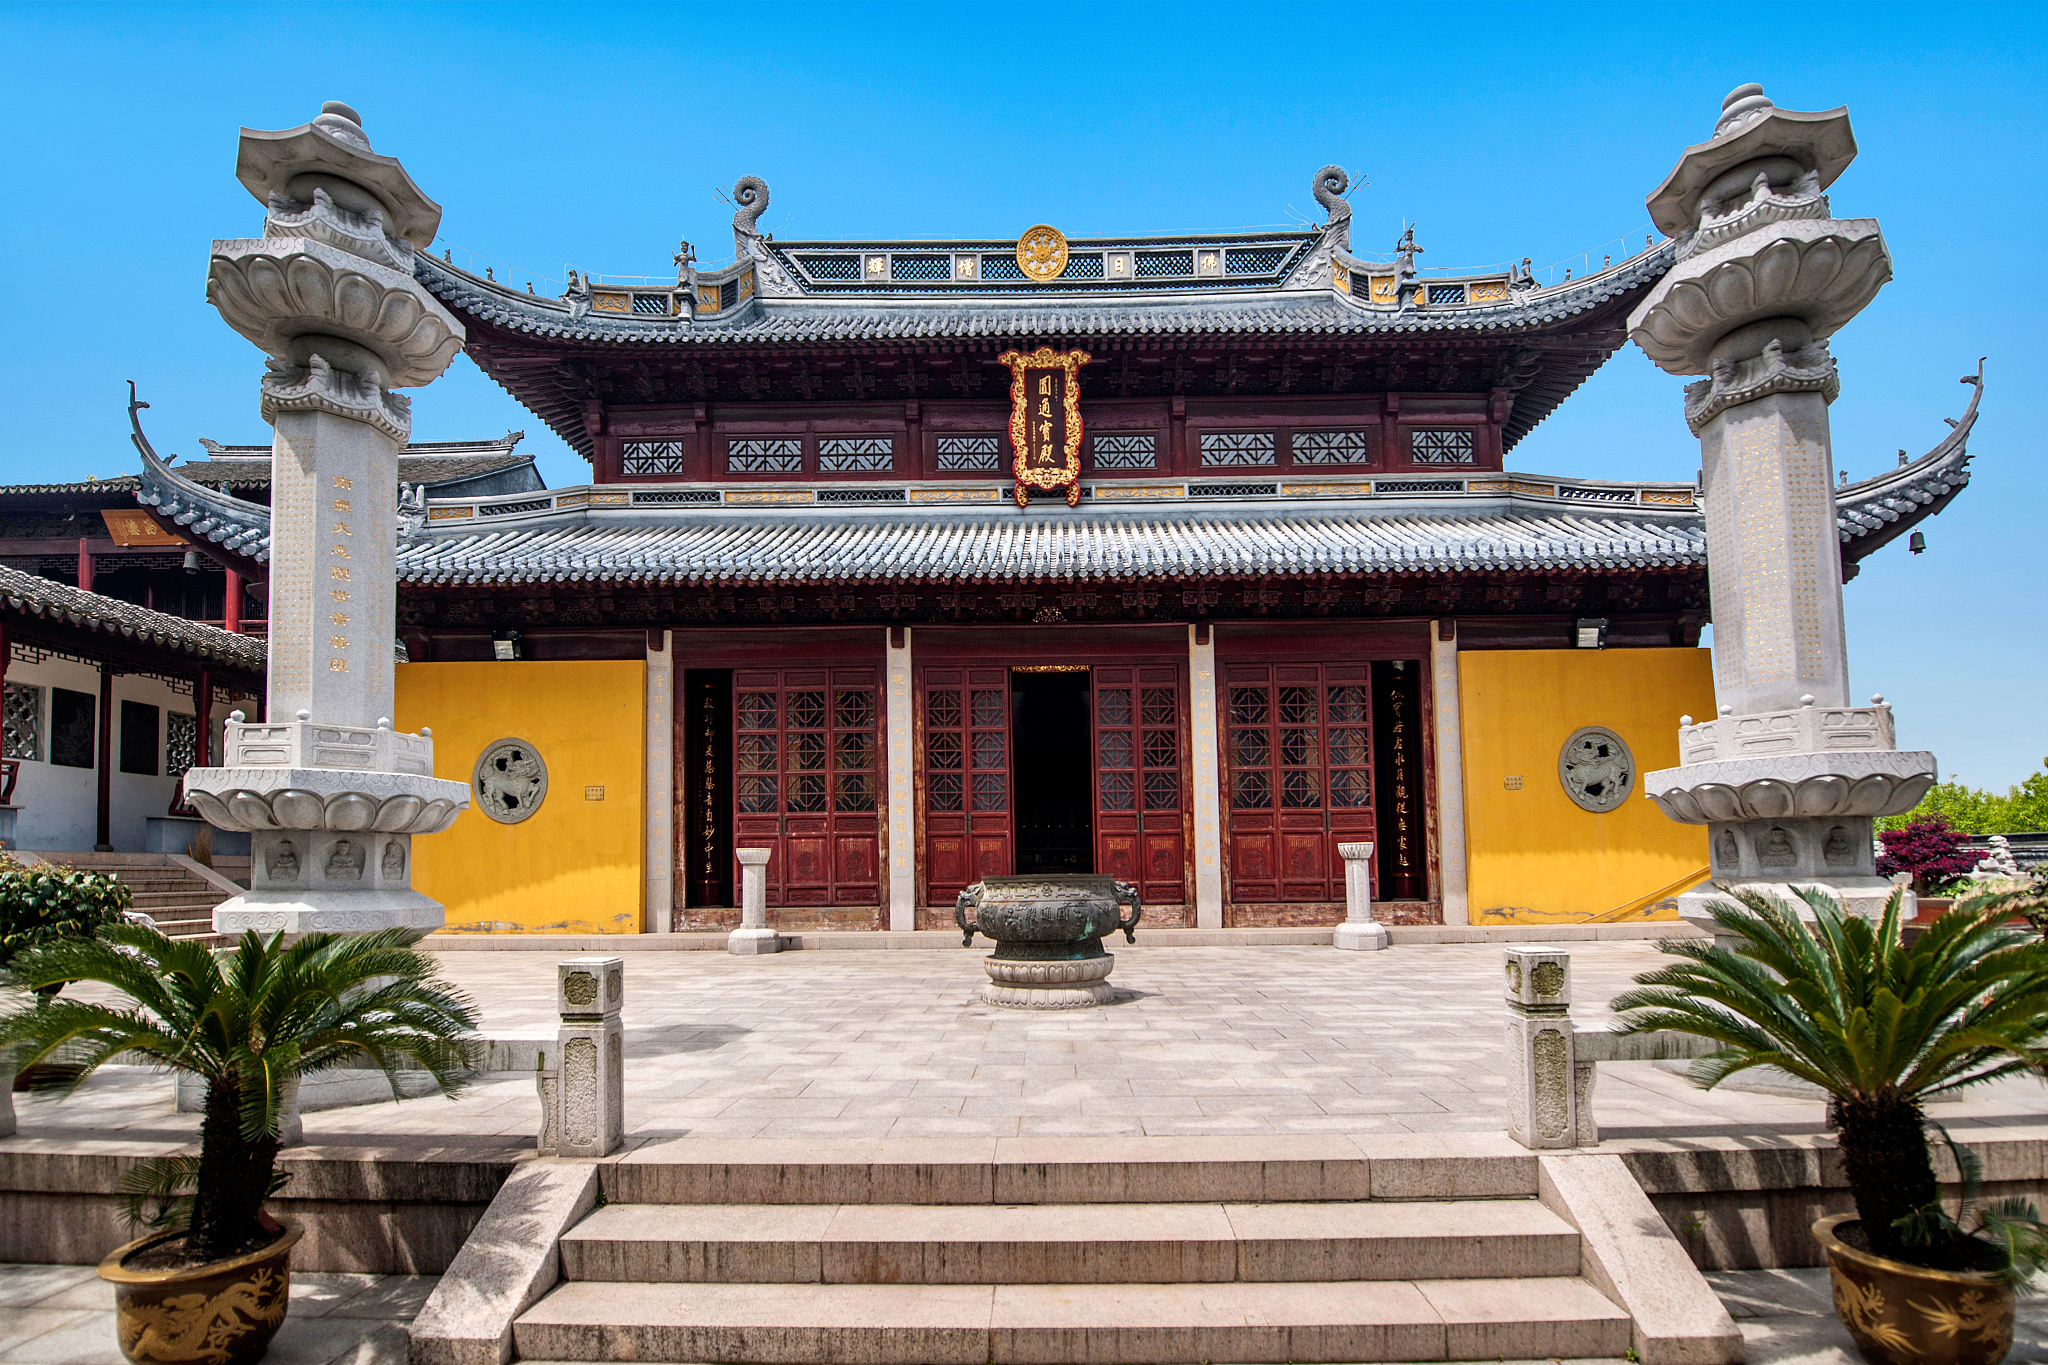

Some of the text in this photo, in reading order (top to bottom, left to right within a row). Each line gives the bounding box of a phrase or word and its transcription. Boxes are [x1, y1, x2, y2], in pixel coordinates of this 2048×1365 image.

[329, 475, 354, 674] 南無大悲觀世音菩薩
